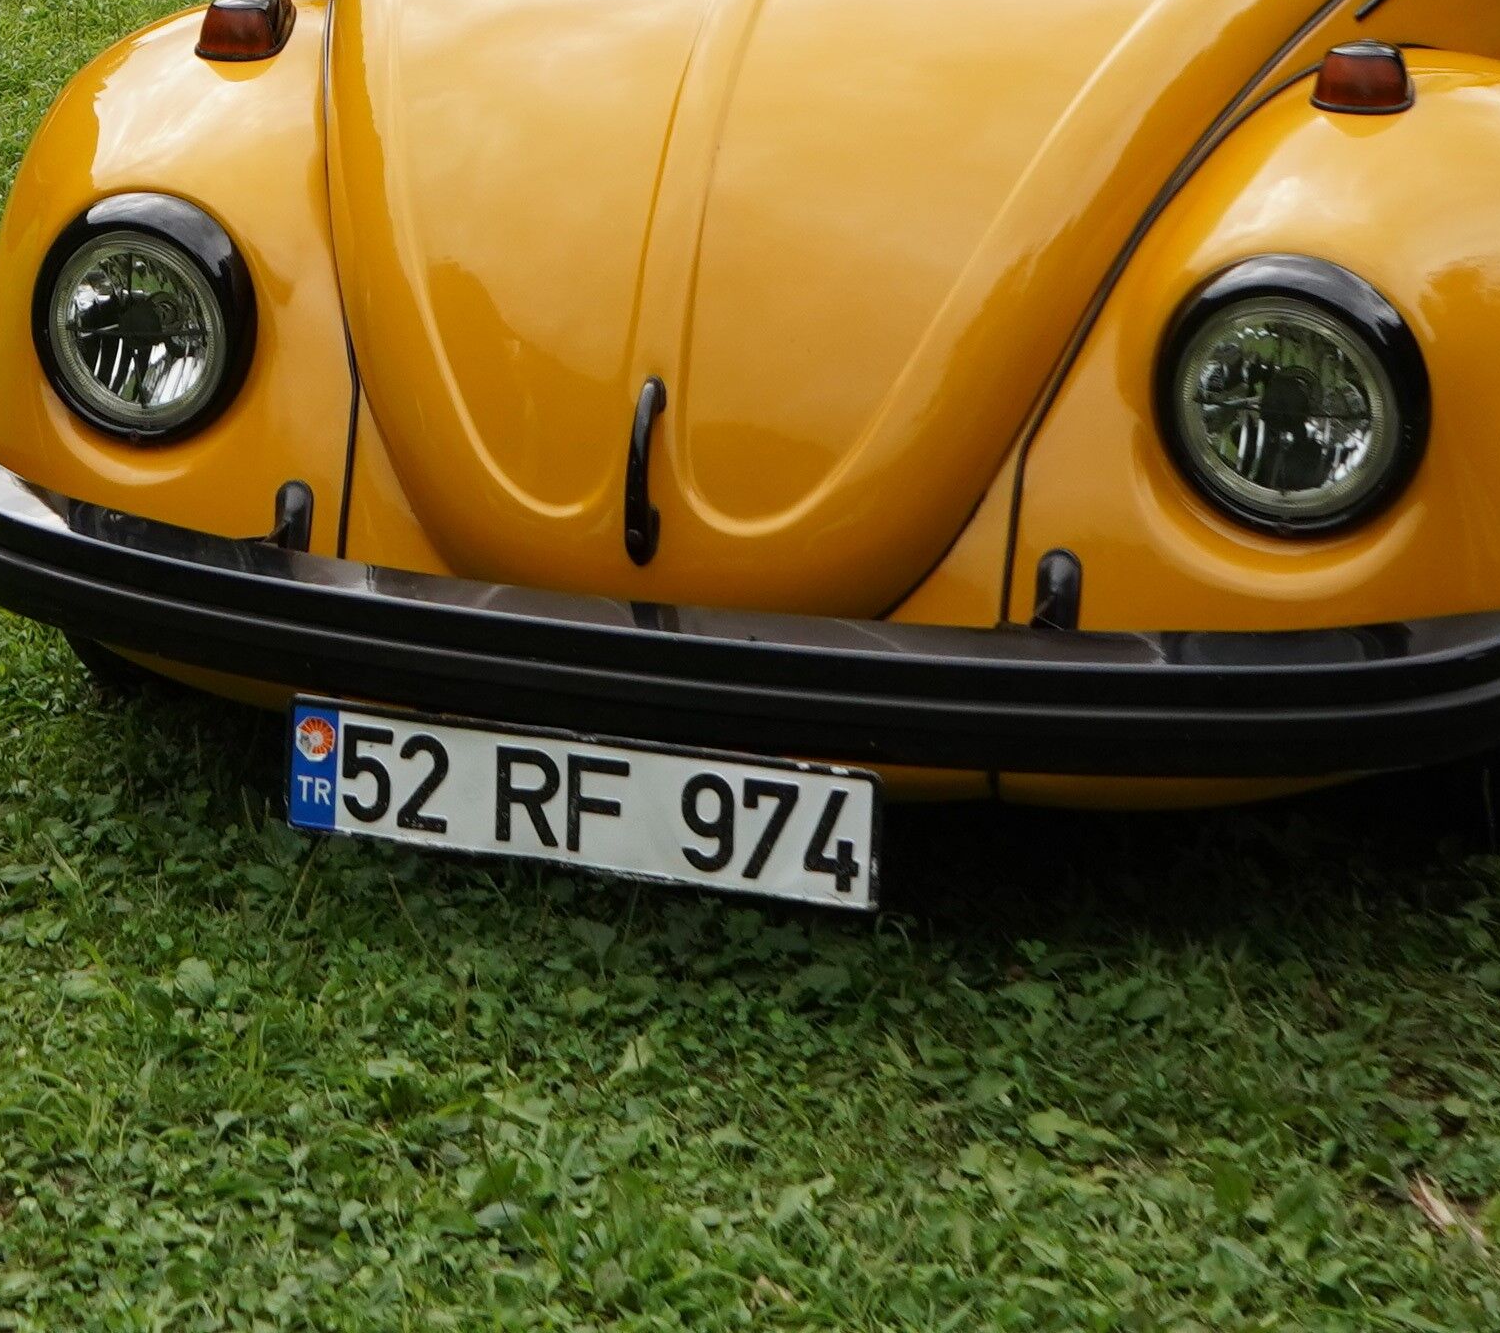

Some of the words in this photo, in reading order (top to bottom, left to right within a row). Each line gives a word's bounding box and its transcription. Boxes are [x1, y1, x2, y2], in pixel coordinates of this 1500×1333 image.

[297, 774, 332, 807] TR
[341, 724, 449, 834] 52
[496, 745, 630, 851] RF
[680, 773, 861, 893] 974
